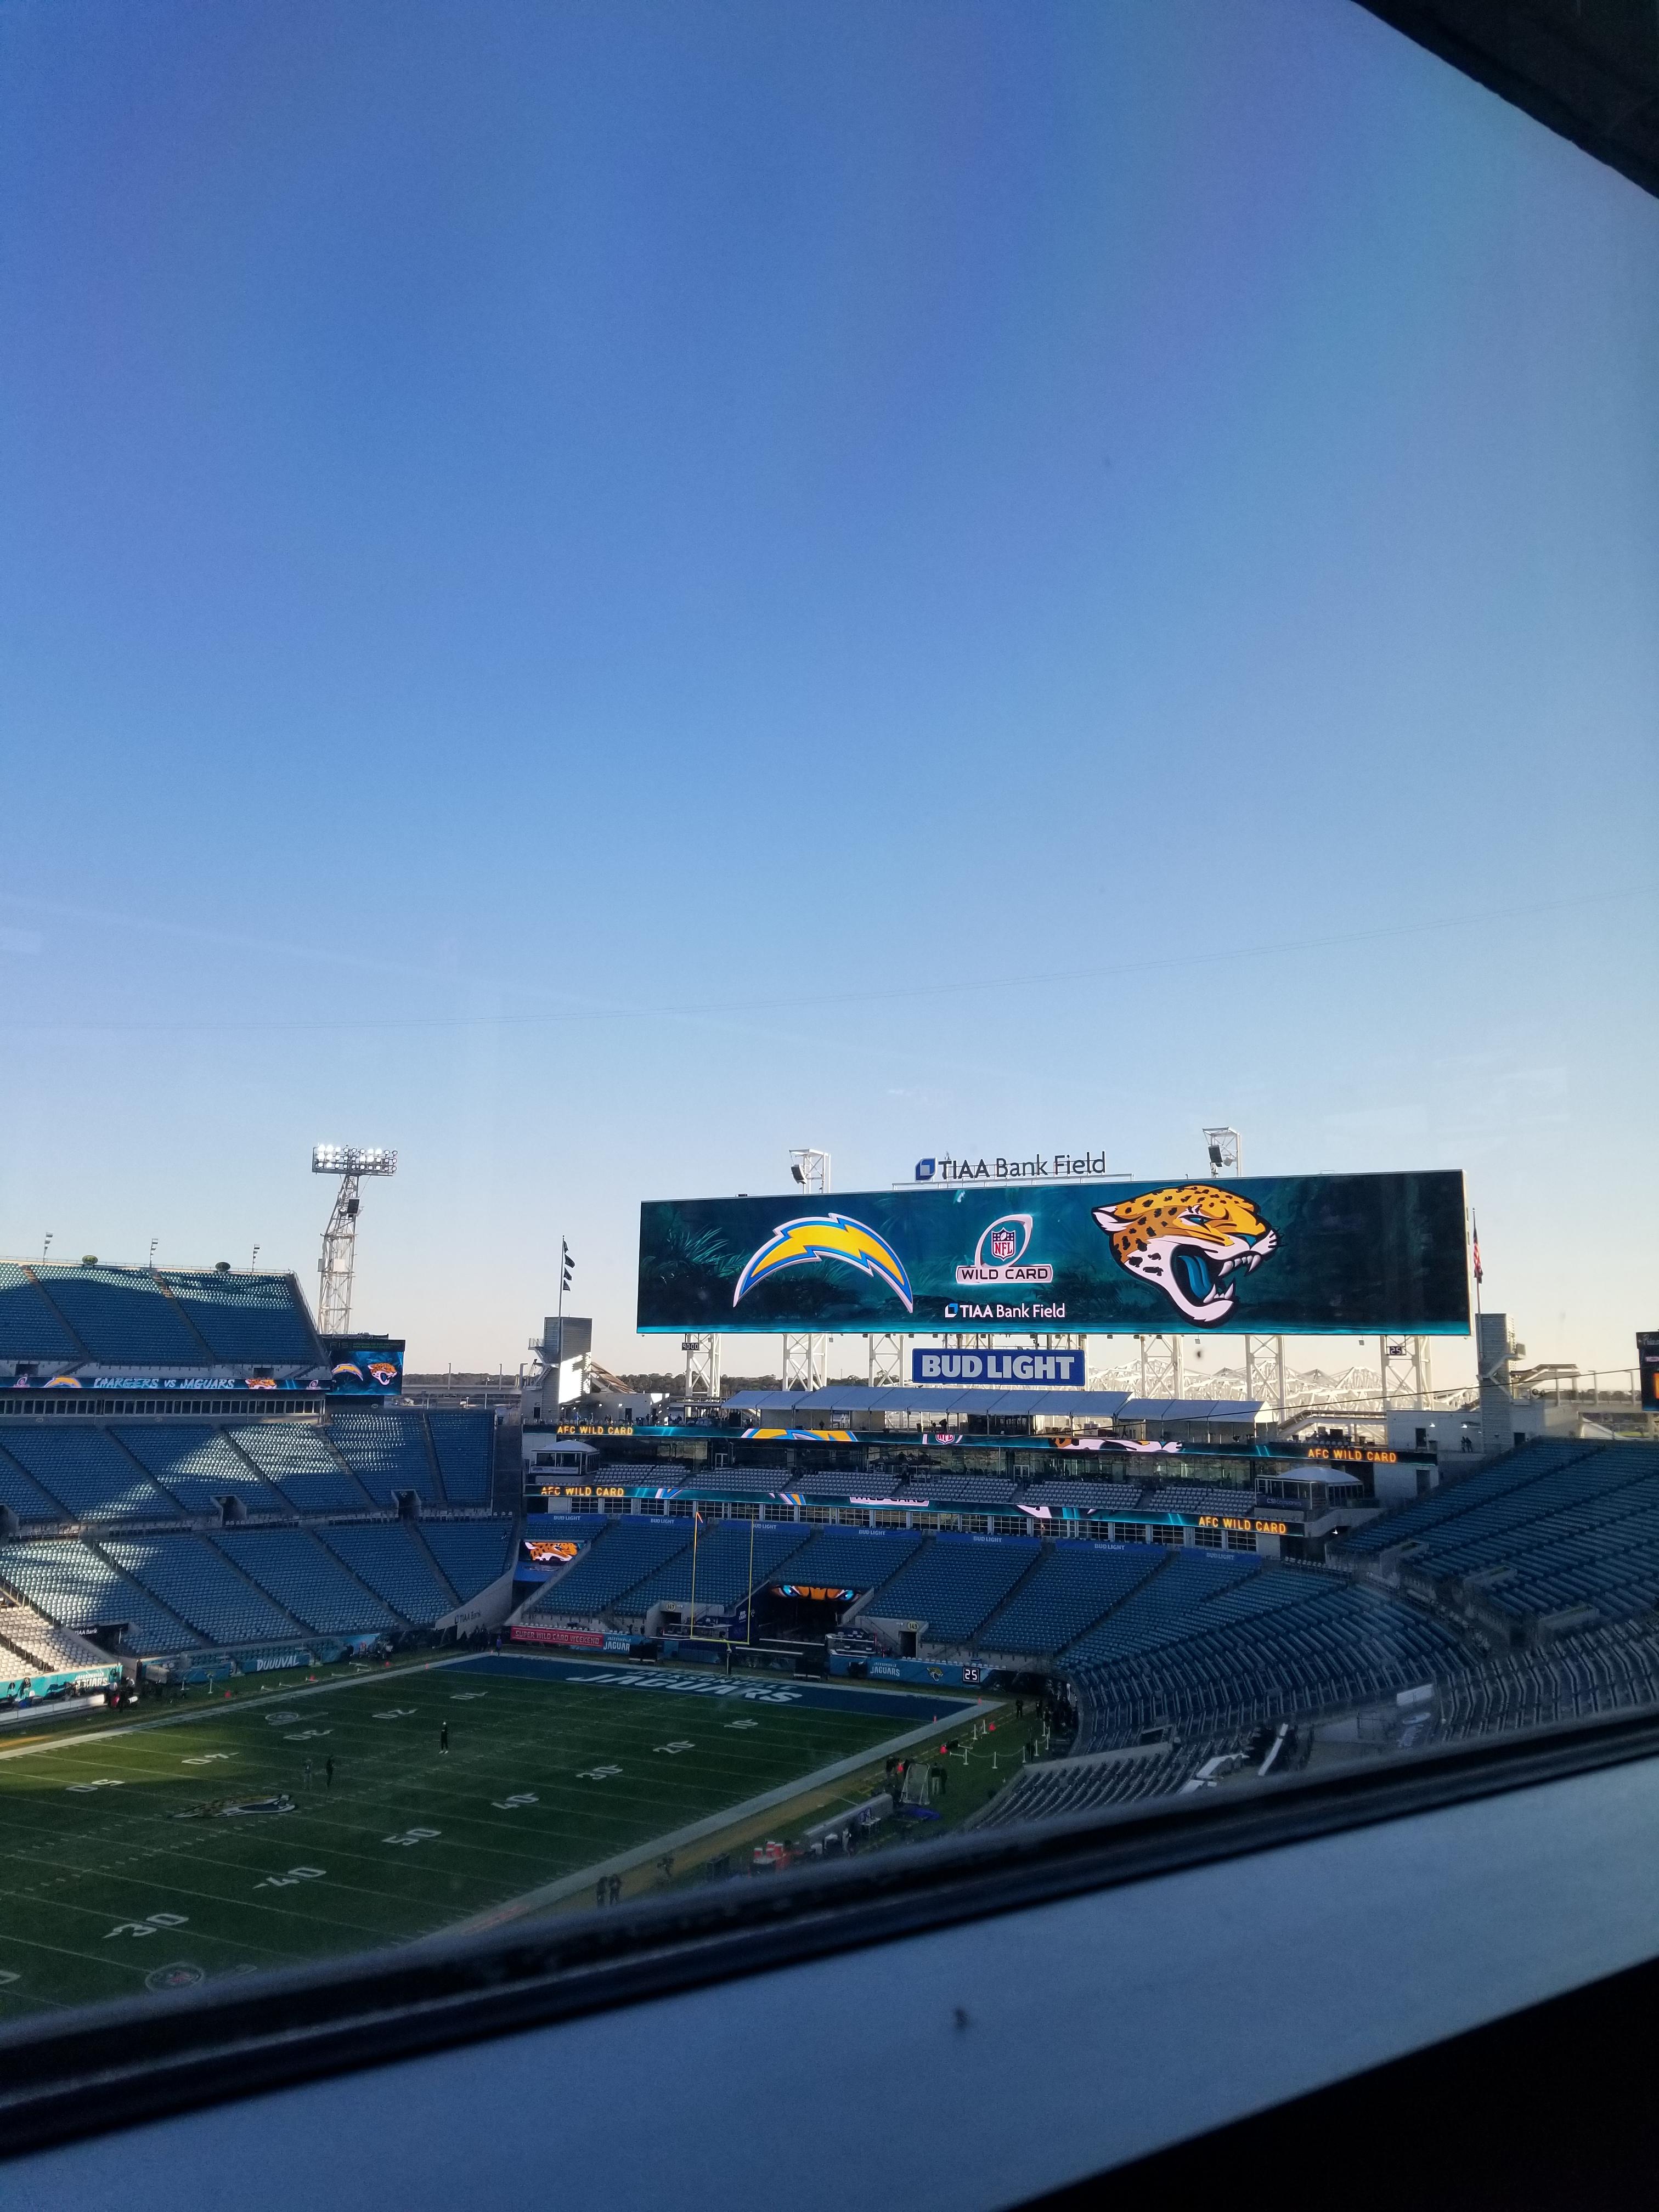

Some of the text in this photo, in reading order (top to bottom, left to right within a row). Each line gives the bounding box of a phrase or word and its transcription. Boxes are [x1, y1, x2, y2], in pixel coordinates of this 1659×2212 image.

[938, 1151, 1105, 1180] TIAA Bank Field
[995, 1242, 1013, 1256] NFL
[962, 1268, 1048, 1280] WILD CARD
[960, 1303, 1065, 1318] TIAA Bank Field
[922, 1355, 1075, 1379] BUD LIGHT
[94, 1378, 159, 1388] CHARGERS
[180, 1379, 235, 1389] JAGUARS
[557, 1425, 575, 1434] AFC
[580, 1426, 603, 1435] WILD
[1308, 1448, 1397, 1463] AFC WILD CARD
[541, 1486, 624, 1497] AFC WILD CARD
[1198, 1516, 1286, 1534] AFC WILD CARD
[515, 1630, 535, 1639] SUPER
[536, 1632, 551, 1640] WILD
[570, 1635, 600, 1645] WEEKEND
[603, 1640, 630, 1651] JAGUAR
[257, 1655, 300, 1672] DUUUVAL
[870, 1666, 900, 1677] JAGUARS
[964, 1669, 978, 1681] 25
[565, 1674, 804, 1703] JAGUARS
[653, 1741, 696, 1754] 20
[575, 1766, 623, 1780] 30
[382, 1828, 442, 1846] 50
[265, 1867, 328, 1887] 40
[111, 1913, 190, 1938] 30
